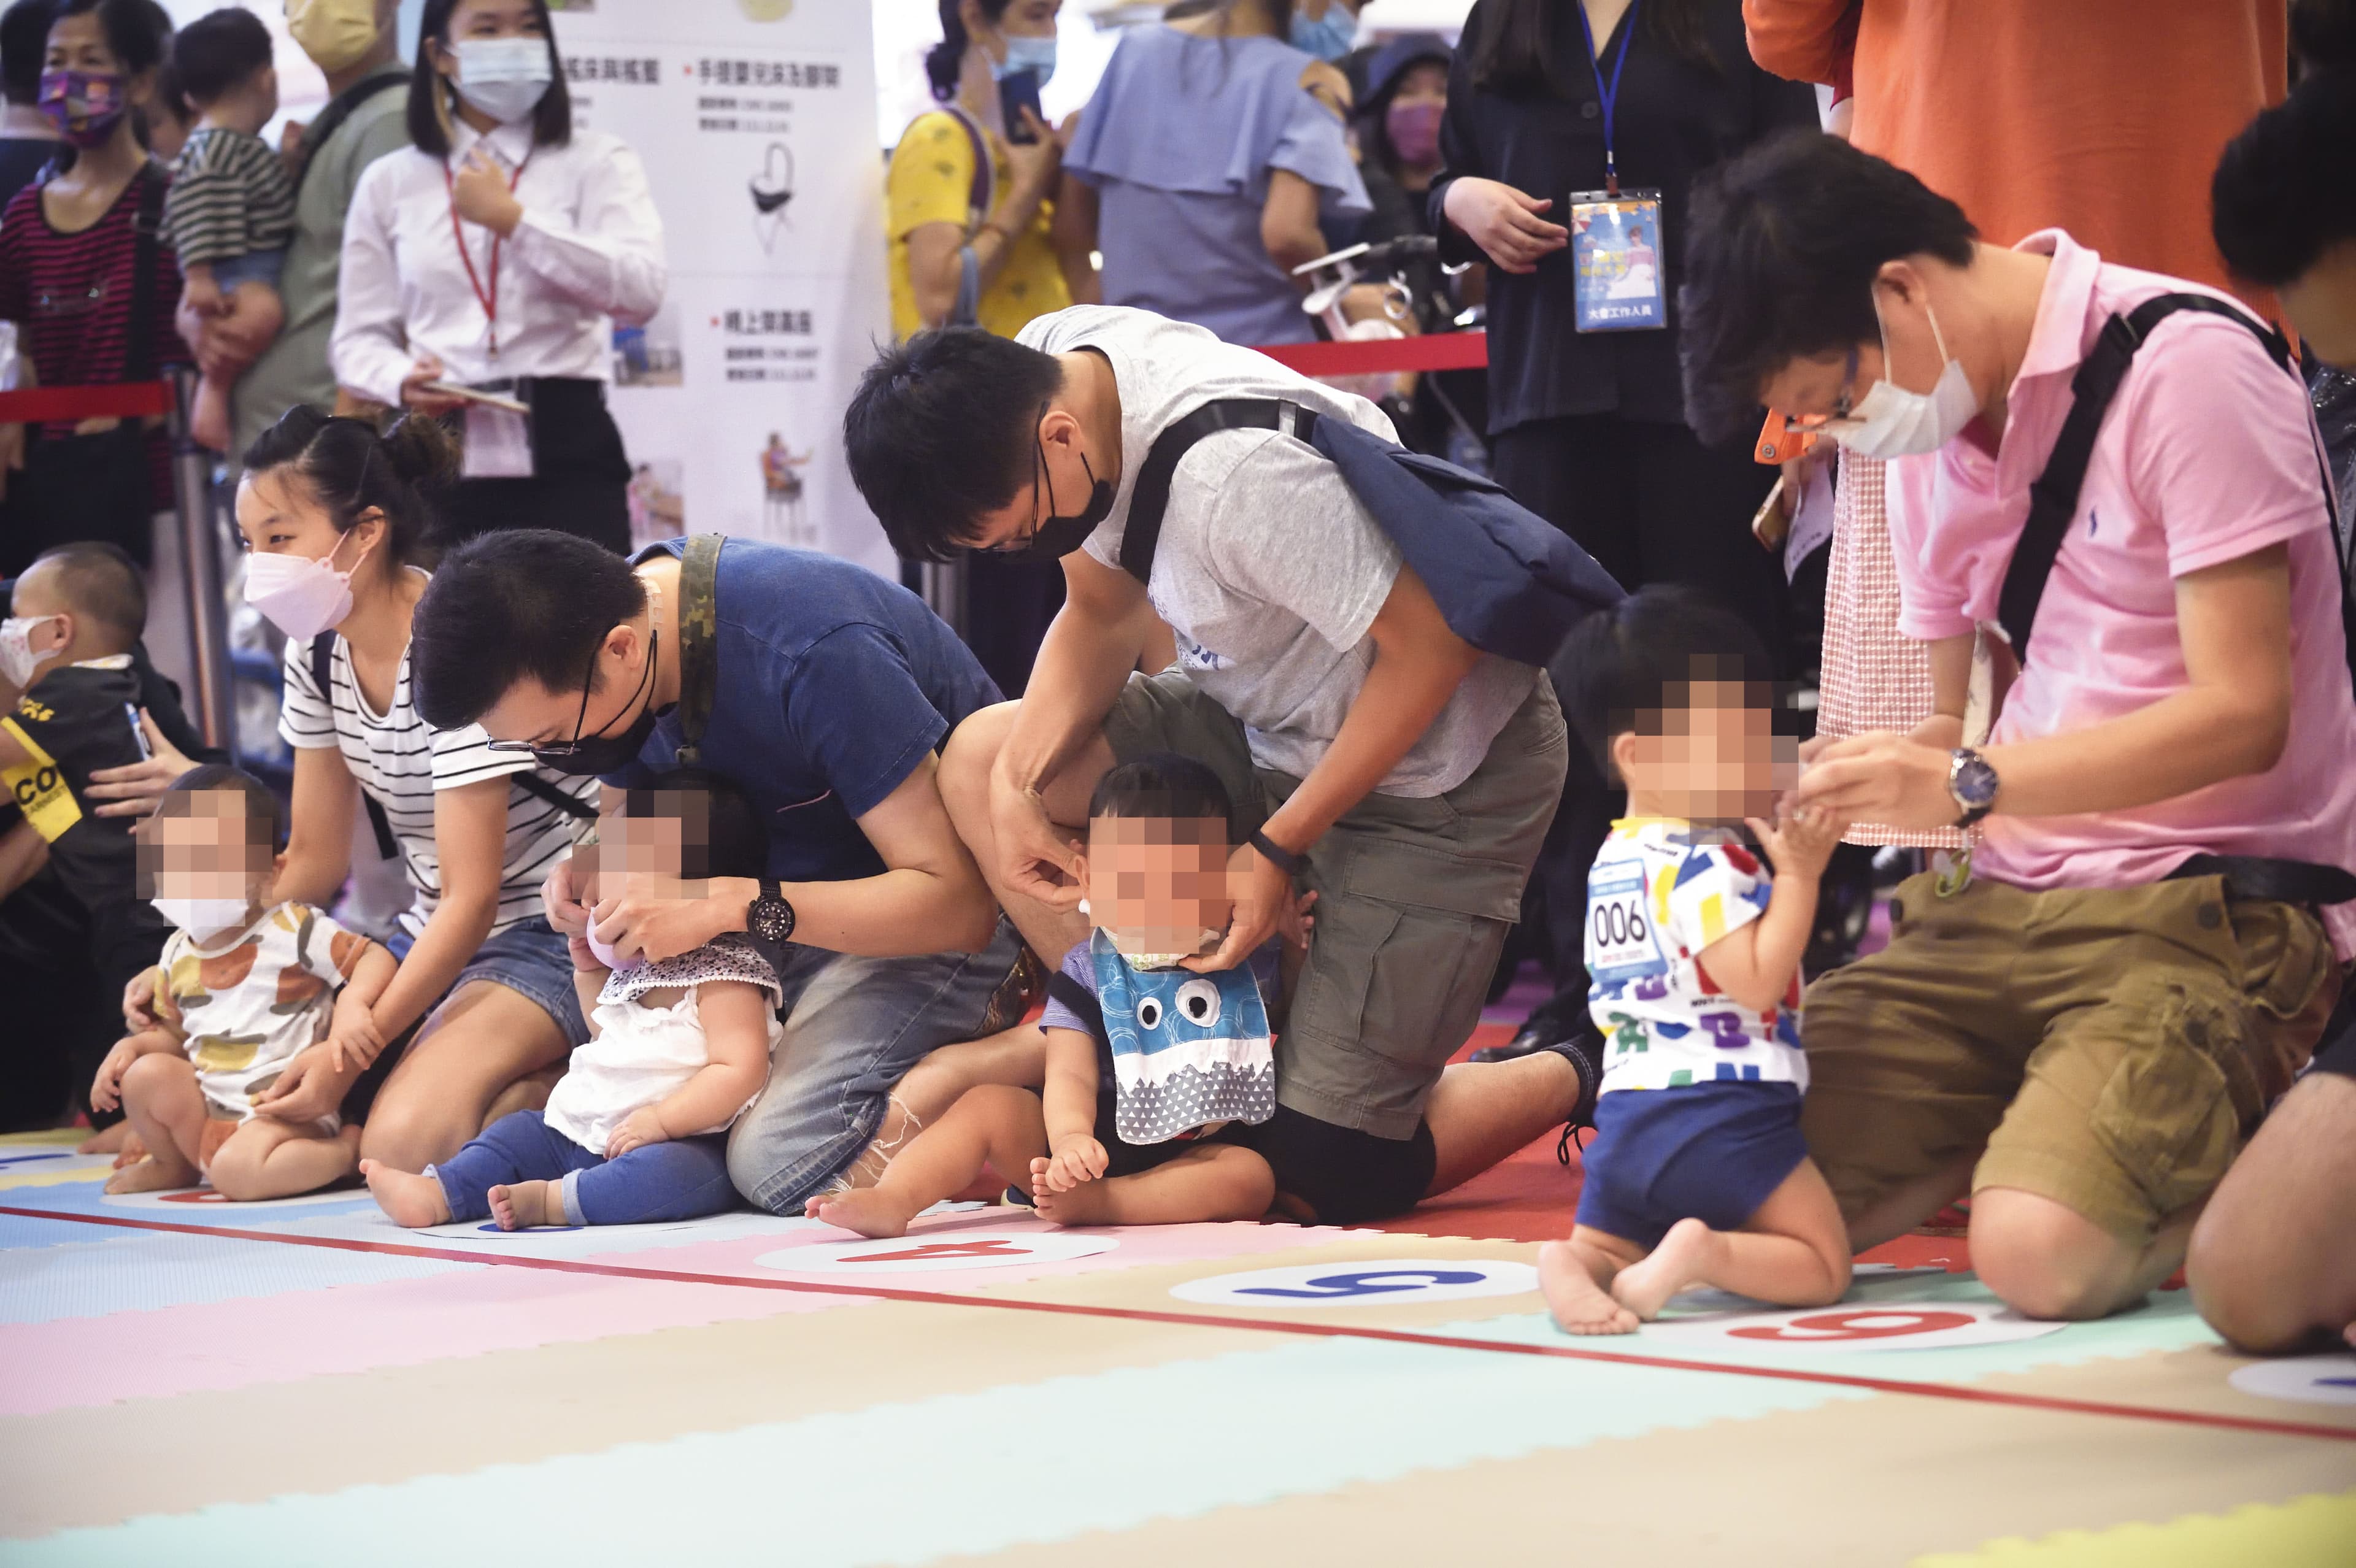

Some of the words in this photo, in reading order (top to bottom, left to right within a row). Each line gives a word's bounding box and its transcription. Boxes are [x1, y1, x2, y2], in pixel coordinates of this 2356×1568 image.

[1595, 899, 1646, 947] 006
[837, 1240, 1032, 1262] 4
[1233, 1270, 1487, 1298] 5
